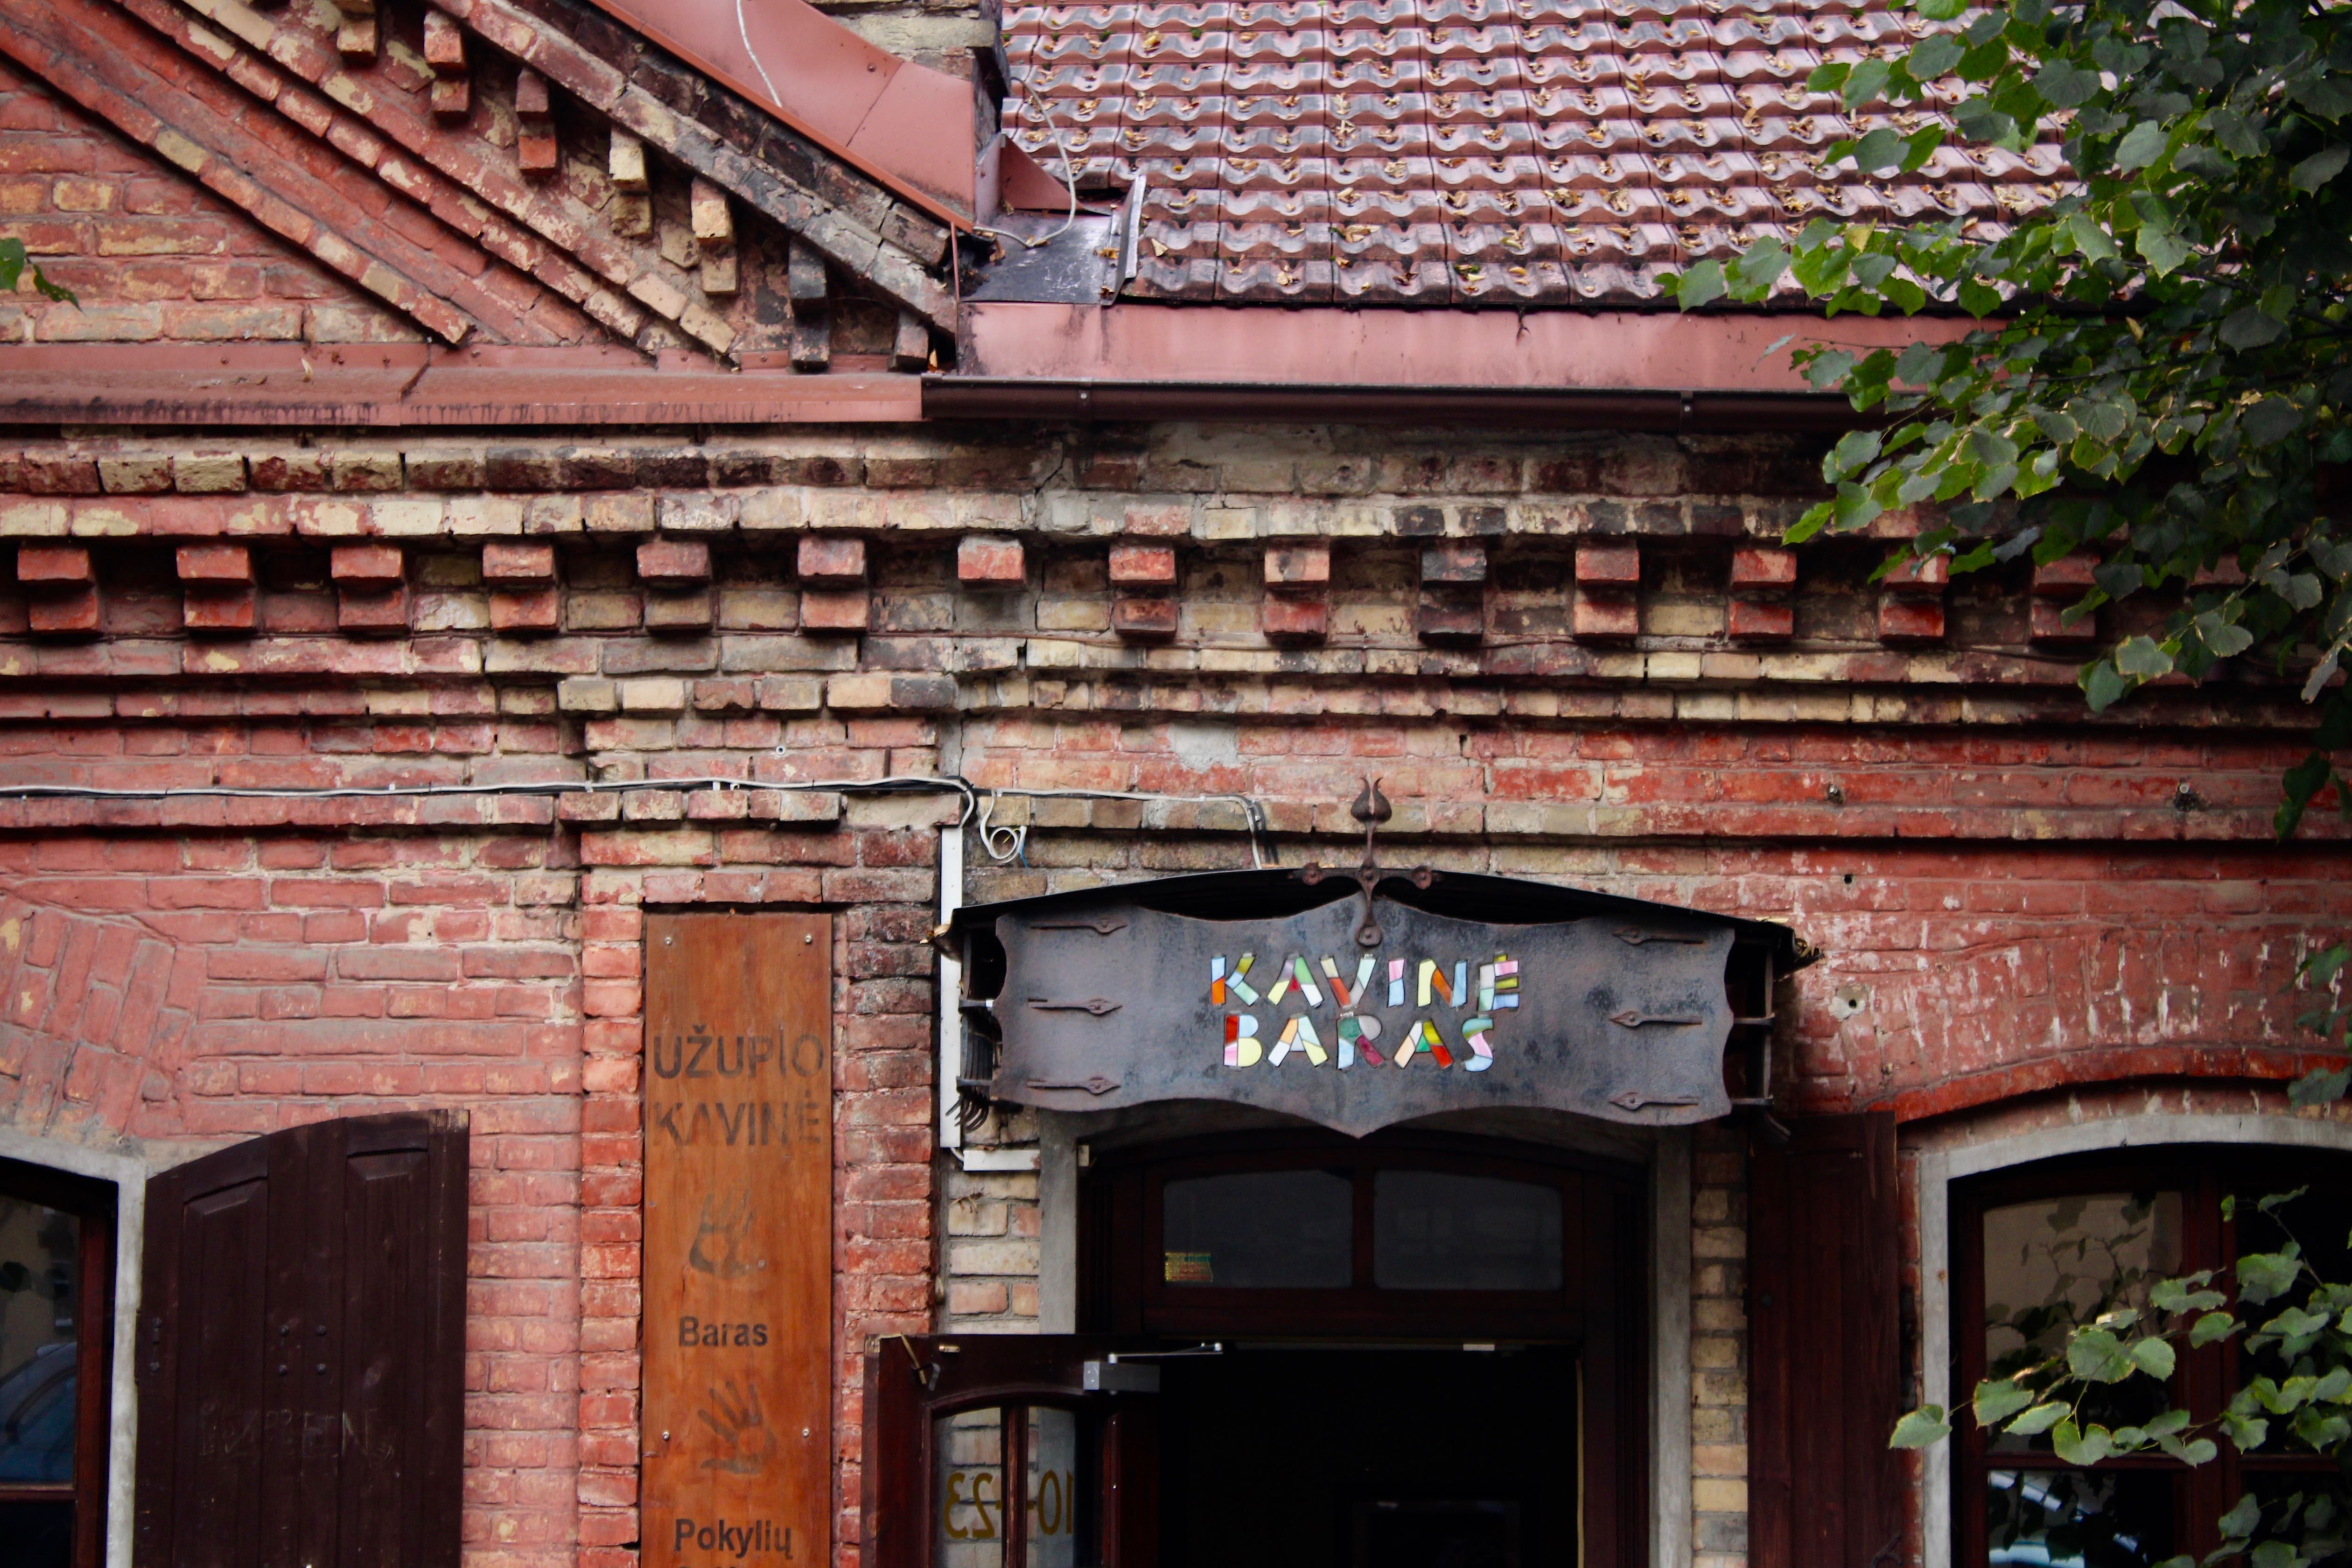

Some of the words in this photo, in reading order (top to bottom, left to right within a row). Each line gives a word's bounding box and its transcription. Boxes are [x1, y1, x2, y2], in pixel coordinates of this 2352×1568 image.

[654, 1024, 824, 1079] UŽUPIO
[1223, 1014, 1493, 1072] BARAS
[653, 1090, 821, 1146] KAVINĖ
[679, 1316, 768, 1347] Baras
[674, 1519, 793, 1560] Pokylių
